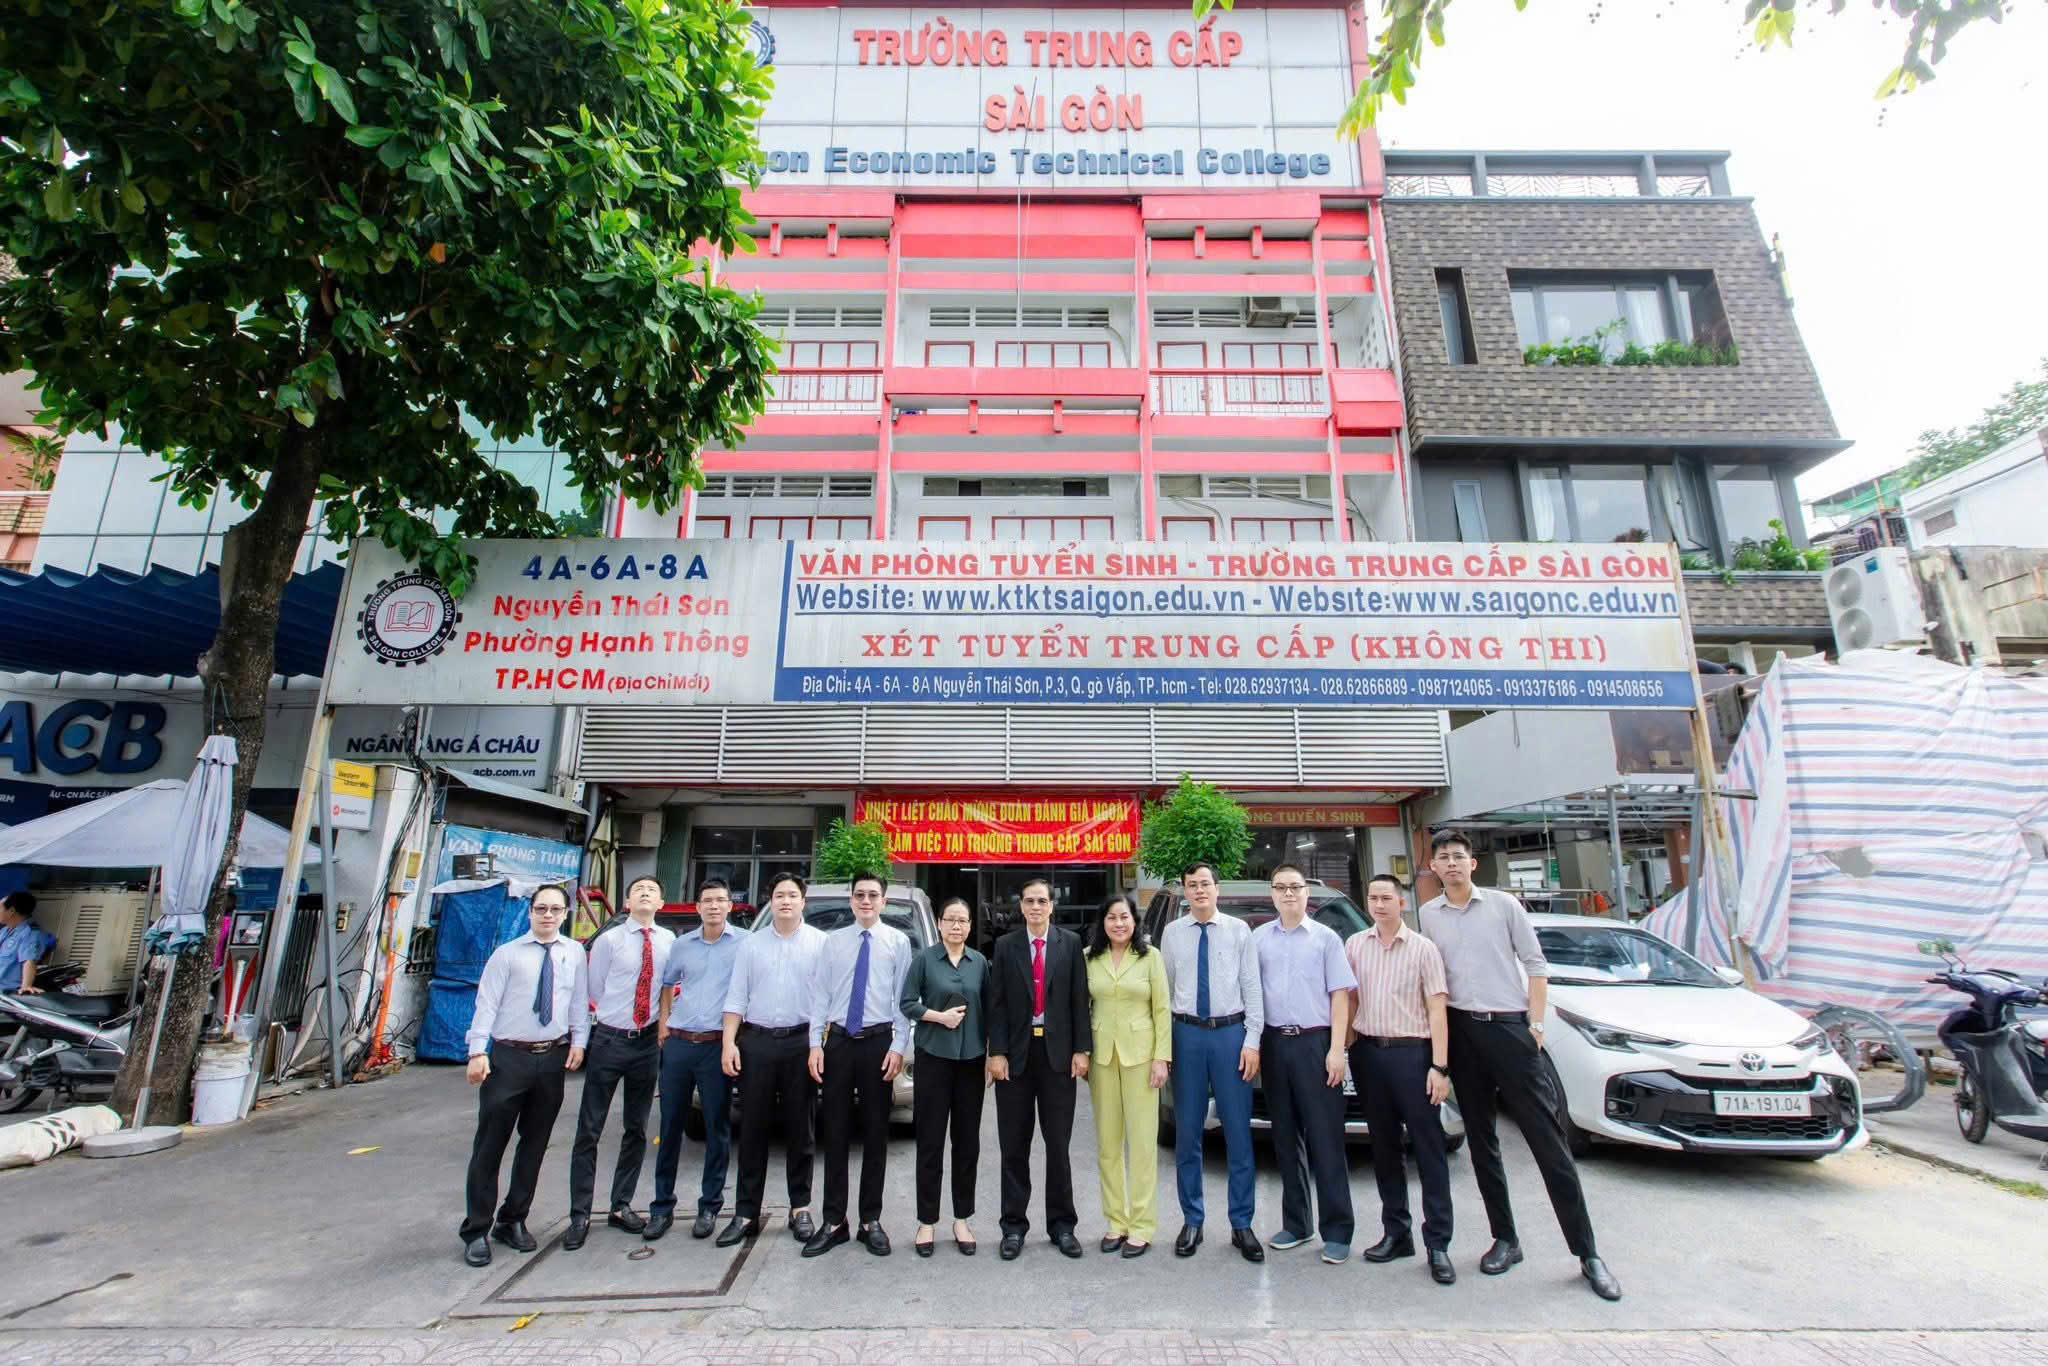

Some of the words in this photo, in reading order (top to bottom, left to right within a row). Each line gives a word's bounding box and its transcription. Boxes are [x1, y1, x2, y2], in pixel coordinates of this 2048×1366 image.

[853, 17, 1007, 66] TRƯỜNG
[1025, 29, 1153, 68] TRUNG
[1168, 16, 1242, 68] CẤP
[984, 84, 1045, 132] SÀI
[1060, 84, 1143, 131] GÒN
[824, 146, 996, 175] Economic
[1010, 147, 1183, 176] Technical
[1197, 146, 1331, 178] College
[521, 554, 708, 581] 4A-6A-8A
[800, 549, 862, 576] VĂN
[872, 547, 979, 576] PHÒNG
[990, 541, 1095, 576] TUYỂN
[1105, 554, 1177, 576] SINH
[1207, 547, 1336, 577] TRƯỜNG
[1346, 554, 1453, 577] TRUNG
[1464, 544, 1527, 577] CẤP
[1539, 547, 1591, 577] SÀI
[1602, 549, 1669, 578] GÒN
[493, 590, 602, 622] Nguyễn
[610, 592, 670, 617] Thái
[679, 594, 730, 616] Sơn
[797, 583, 914, 611] Website:
[922, 583, 1246, 618] www.ktktsaigon.edu.vn
[401, 635, 444, 658] COLLEGE
[464, 630, 574, 659] Phường
[580, 631, 654, 658] Hạnh
[663, 628, 750, 658] Thông
[862, 628, 941, 658] XÉT
[957, 623, 1090, 659] TUYỂN
[1105, 634, 1240, 660] TRUNG
[1256, 623, 1335, 660] CẤP
[1351, 630, 1502, 661] (KHÔNG
[1520, 634, 1607, 662] THI)
[495, 667, 605, 690] TP.HCM
[803, 675, 823, 697] Địa
[826, 669, 852, 694] Chỉ:
[854, 676, 872, 693] 4A
[883, 676, 900, 693] 6A
[912, 676, 930, 693] 8A
[934, 672, 982, 698] Nguyễn
[984, 676, 1012, 694] Thái
[1014, 676, 1043, 697] Sơn,
[1045, 676, 1068, 697] P.3,
[1071, 676, 1085, 696] Q.
[1088, 677, 1103, 699] gò
[1106, 673, 1135, 698] Vấp,
[1162, 677, 1187, 694] hcm
[1198, 677, 1222, 695] Tel:
[1225, 677, 1310, 695] 028.62937134
[1320, 677, 1408, 696] 028.62866889
[1418, 678, 1493, 696] 0987124065
[1504, 678, 1577, 697] 0913376186
[1587, 679, 1663, 698] 0914508656
[0, 699, 166, 775] ACB
[346, 734, 403, 753] NGÂN
[466, 735, 482, 753] Á
[485, 735, 540, 754] CHÂU
[472, 767, 537, 777] acb.com.vn
[865, 800, 898, 823] NHIỆT
[901, 799, 925, 824] LIỆT
[928, 798, 959, 822] CHÀO
[1034, 798, 1066, 822] ĐÁNH
[1069, 798, 1089, 822] GIÁ
[1093, 798, 1129, 822] NGOÀI
[1329, 811, 1365, 823] SINH
[887, 829, 913, 853] LÀM
[916, 829, 942, 857] VIỆC
[945, 832, 963, 857] TẠI
[967, 829, 1012, 854] TRƯỜNG
[1016, 833, 1054, 854] TRUNG
[1057, 827, 1081, 854] CẤP
[1084, 829, 1104, 854] SÀI
[1107, 829, 1132, 854] GÒN
[1722, 1096, 1802, 1112] 71A-191.04
